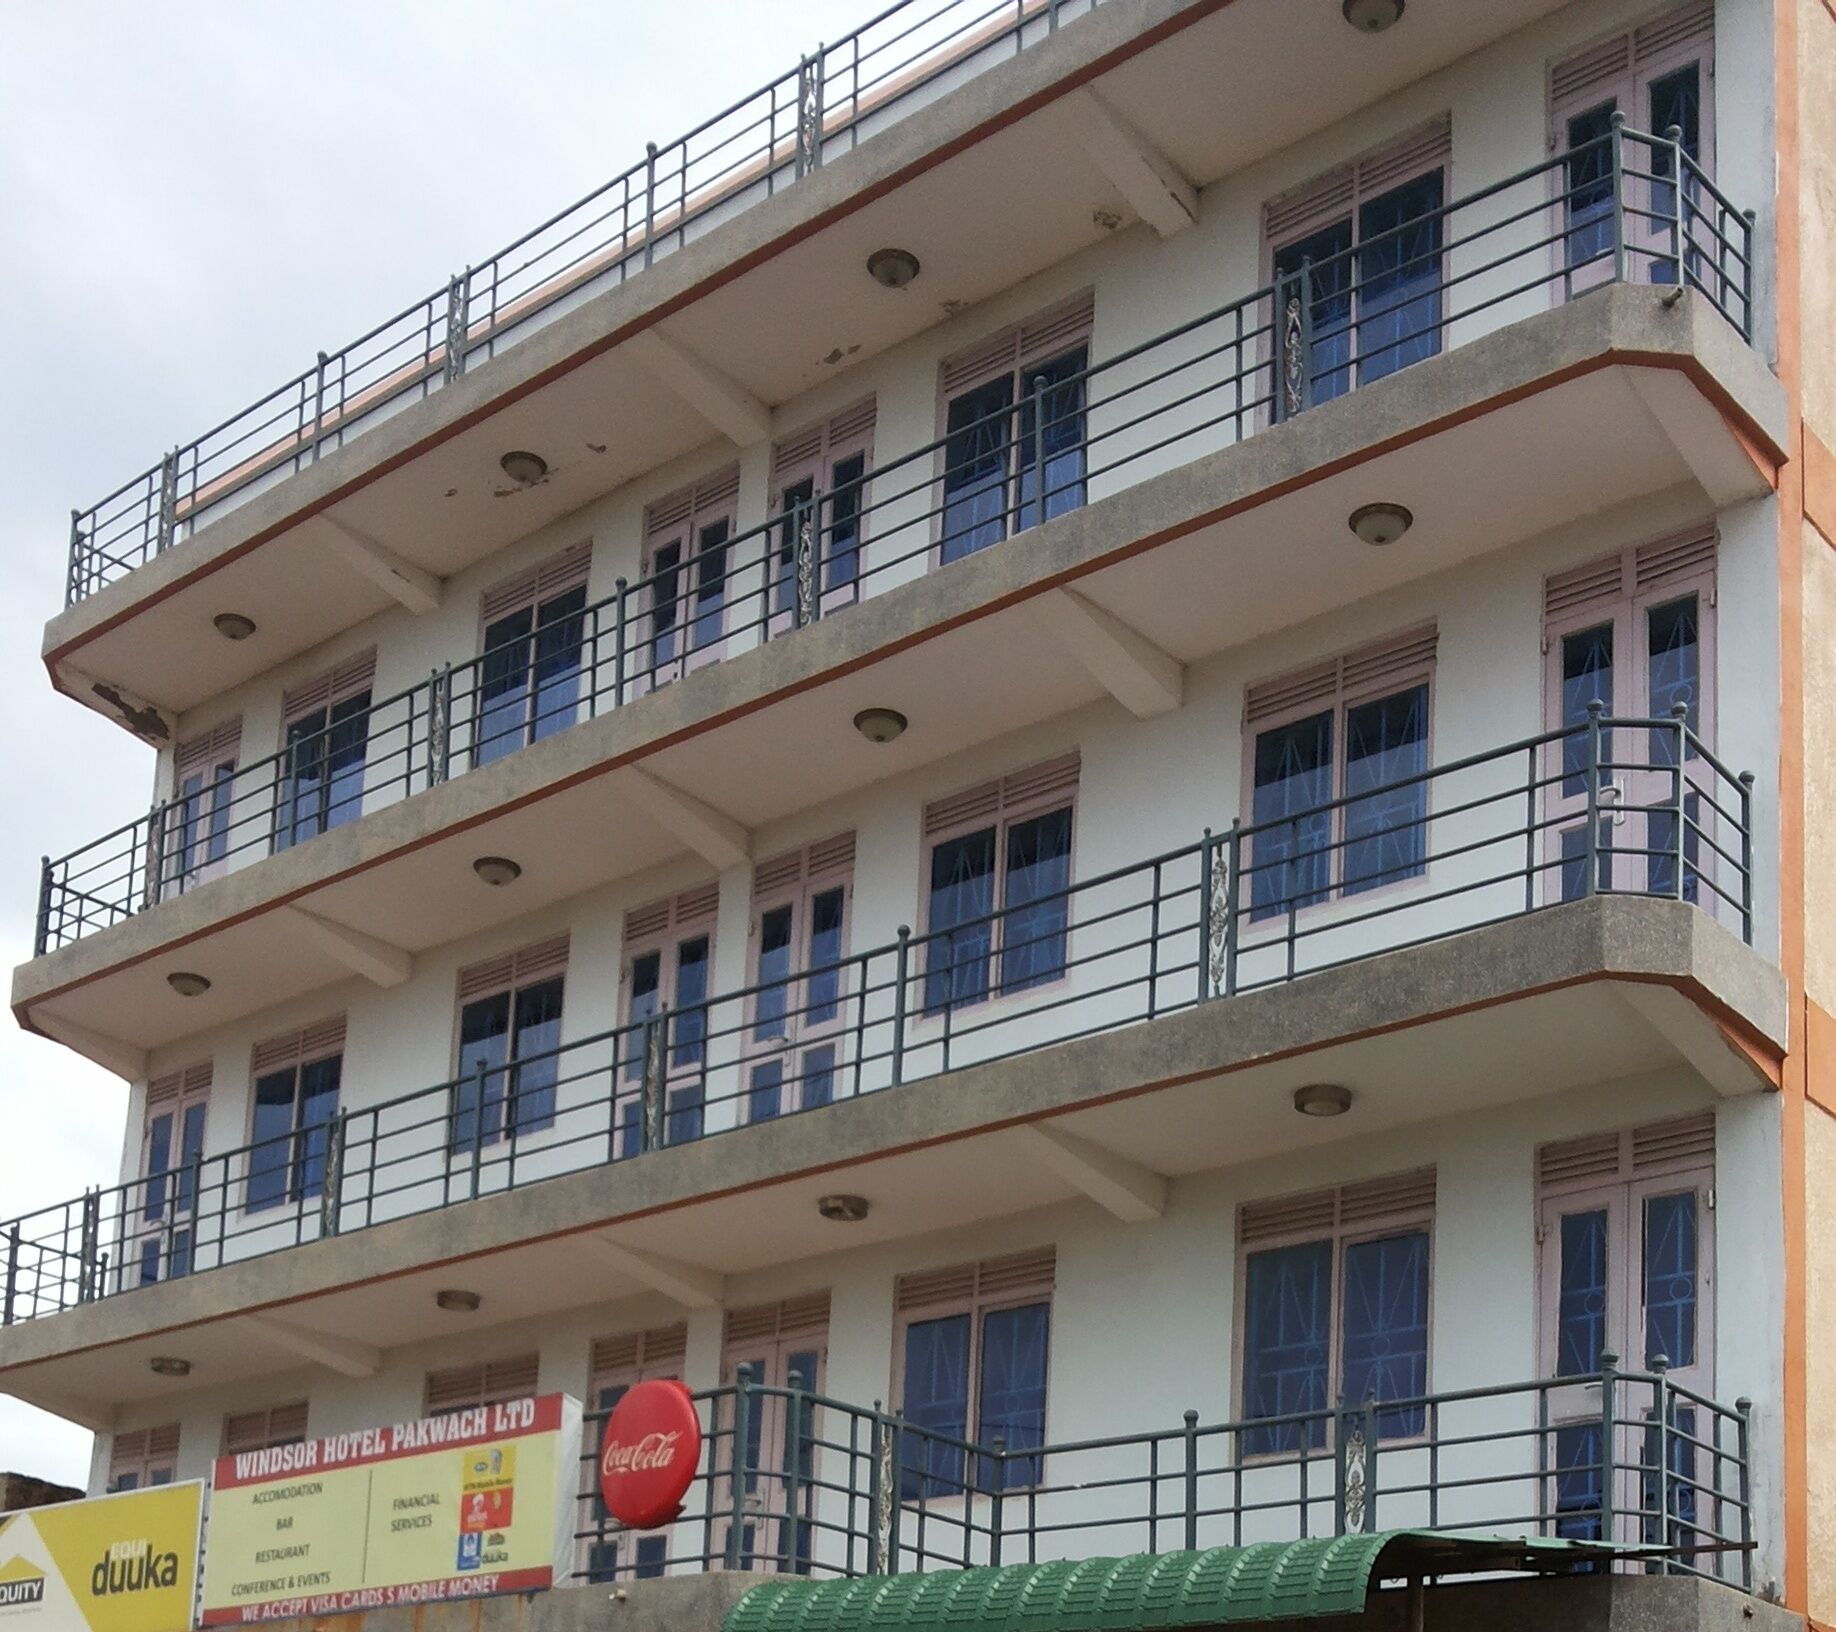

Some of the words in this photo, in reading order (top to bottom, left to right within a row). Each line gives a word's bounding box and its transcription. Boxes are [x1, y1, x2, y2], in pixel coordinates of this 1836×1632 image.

[235, 1440, 319, 1480] WINDSOR
[323, 1427, 386, 1465] HOTEL
[391, 1406, 488, 1451] PAKWACH
[493, 1398, 535, 1433] LTD
[252, 1482, 323, 1505] ACCOMODATION
[393, 1492, 441, 1511] FINANCIAL
[276, 1516, 293, 1531] BAR
[391, 1514, 432, 1533] SERVICES
[255, 1543, 310, 1564] RESTAURANT
[91, 1544, 178, 1597] duuka
[231, 1576, 286, 1597] CONFERENCE
[287, 1576, 295, 1588] &
[297, 1571, 331, 1588] EVENTS
[241, 1605, 259, 1622] WE
[262, 1598, 310, 1619] ACCEPT
[311, 1594, 338, 1614] VISA
[341, 1586, 384, 1609] CARDS
[398, 1582, 447, 1603] MOBILE
[449, 1574, 500, 1597] MONEY
